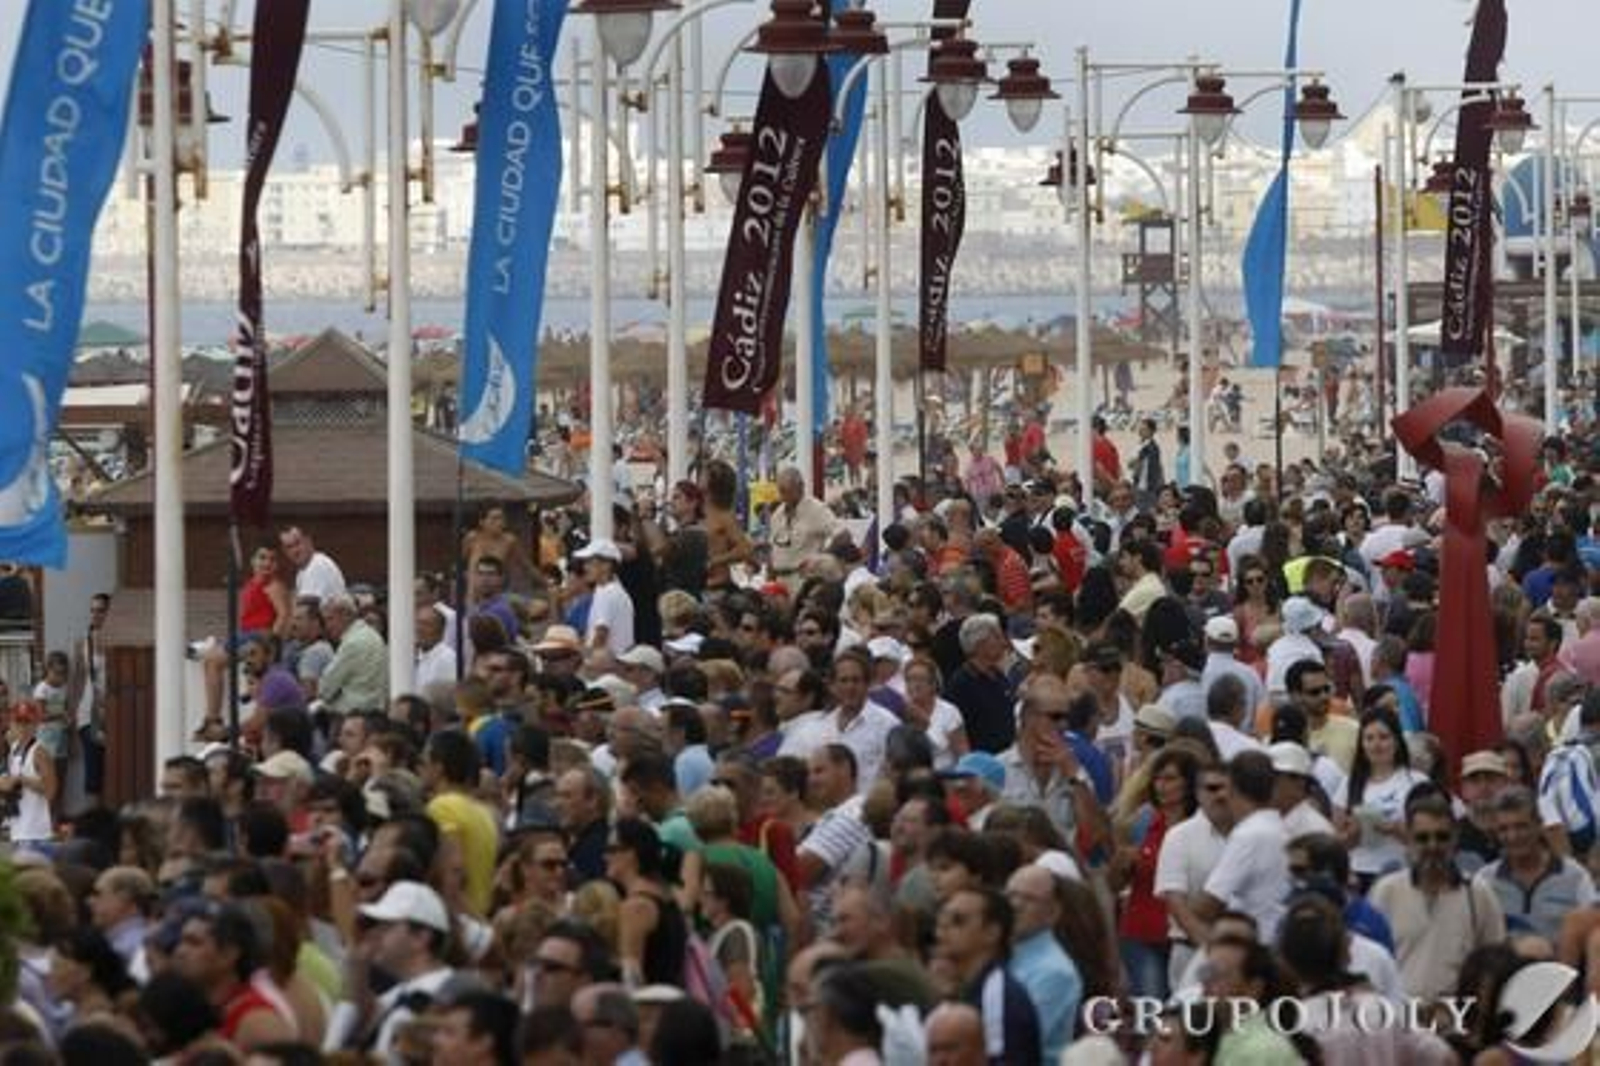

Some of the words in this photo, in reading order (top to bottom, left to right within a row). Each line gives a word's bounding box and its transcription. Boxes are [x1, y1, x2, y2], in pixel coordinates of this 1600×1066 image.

[61, 0, 112, 84] QUE
[31, 97, 80, 265] CIUDAD
[500, 122, 531, 247] CIUDAD
[931, 139, 960, 234] 2012
[1452, 167, 1476, 246] 2012
[495, 256, 511, 294] LA
[720, 271, 764, 392] Cádiz
[744, 127, 788, 245] 2012
[24, 281, 57, 331] LA
